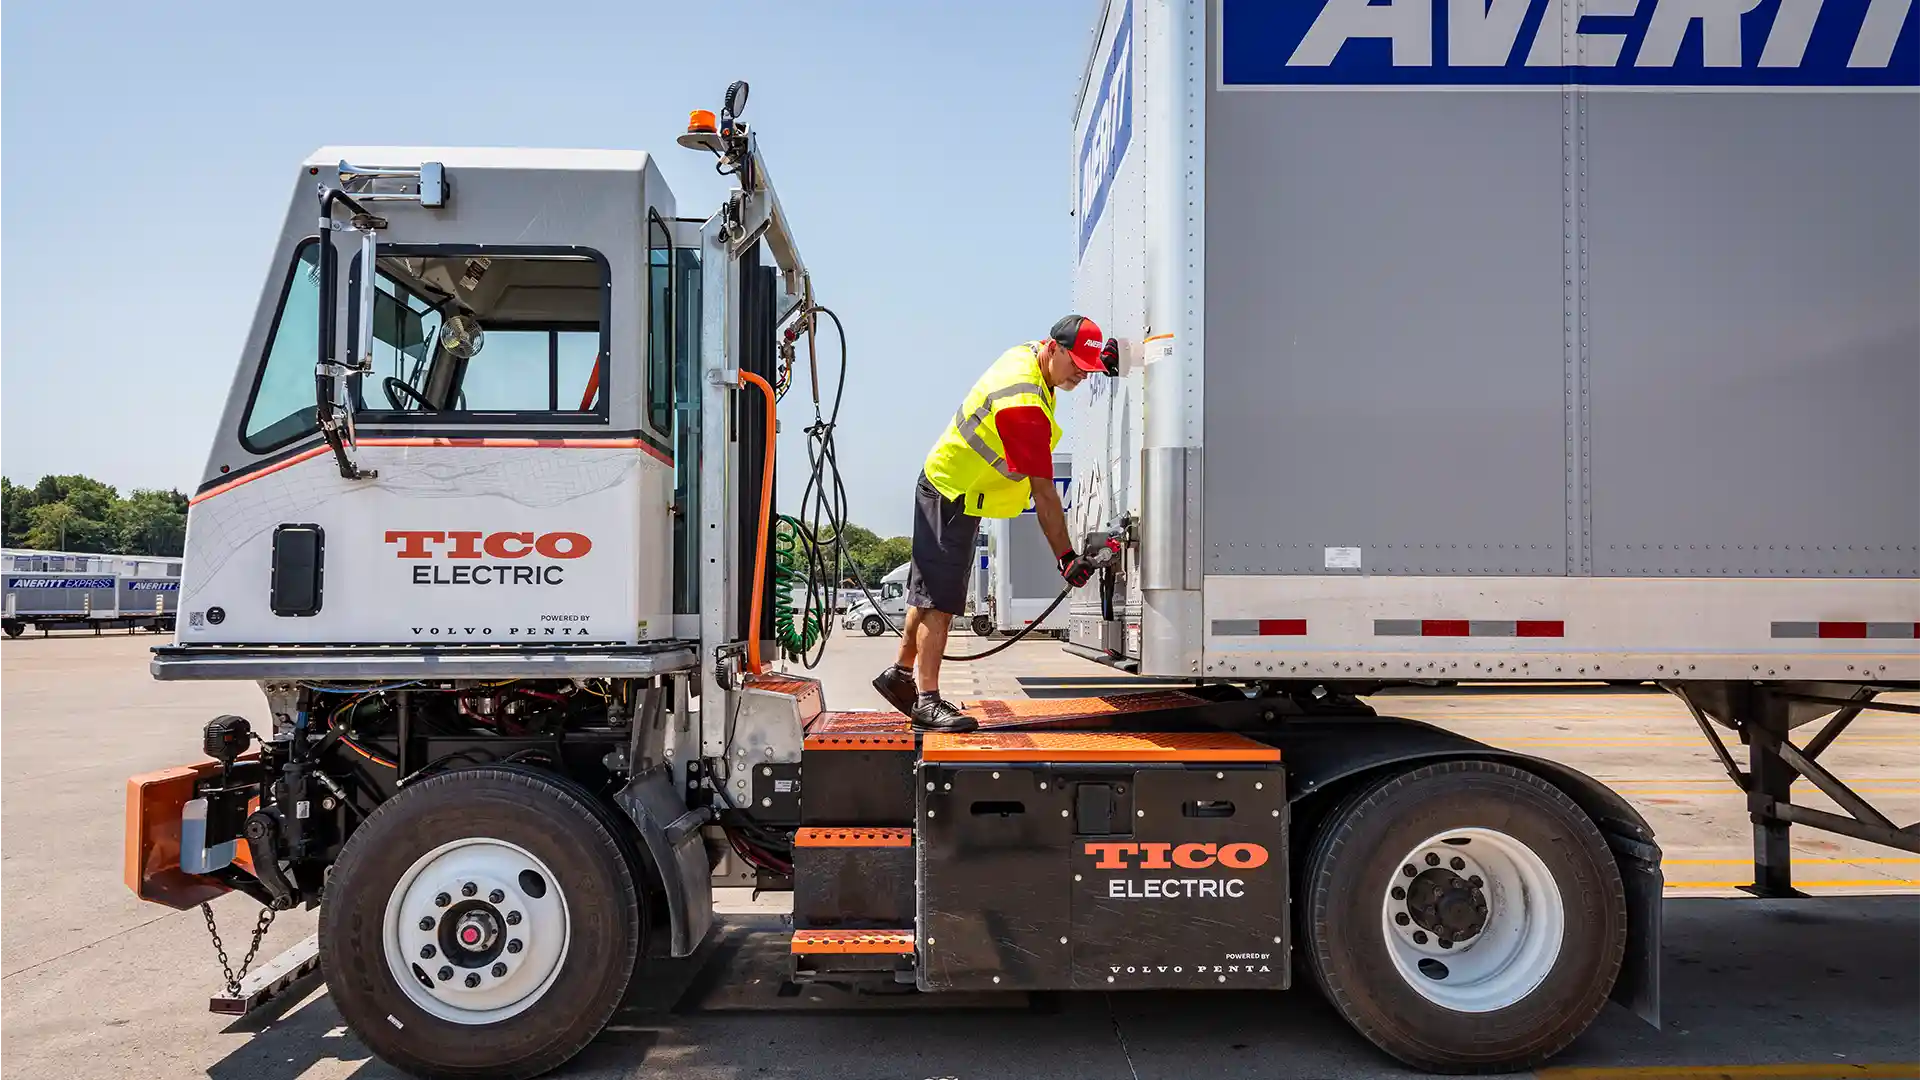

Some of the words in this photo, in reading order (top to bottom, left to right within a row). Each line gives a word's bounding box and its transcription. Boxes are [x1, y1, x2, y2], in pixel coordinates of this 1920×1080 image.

[385, 530, 593, 559] TICO
[413, 565, 564, 585] ELECTRIC
[14, 579, 65, 588] AVERITT
[65, 579, 112, 588] EXPRESS
[133, 582, 174, 590] AVERITT
[411, 627, 492, 635] VOLVO
[509, 627, 589, 635] PENTA
[1085, 842, 1269, 869] TICO
[1109, 879, 1245, 898] ELECTRIC
[1197, 965, 1271, 973] PENTA
